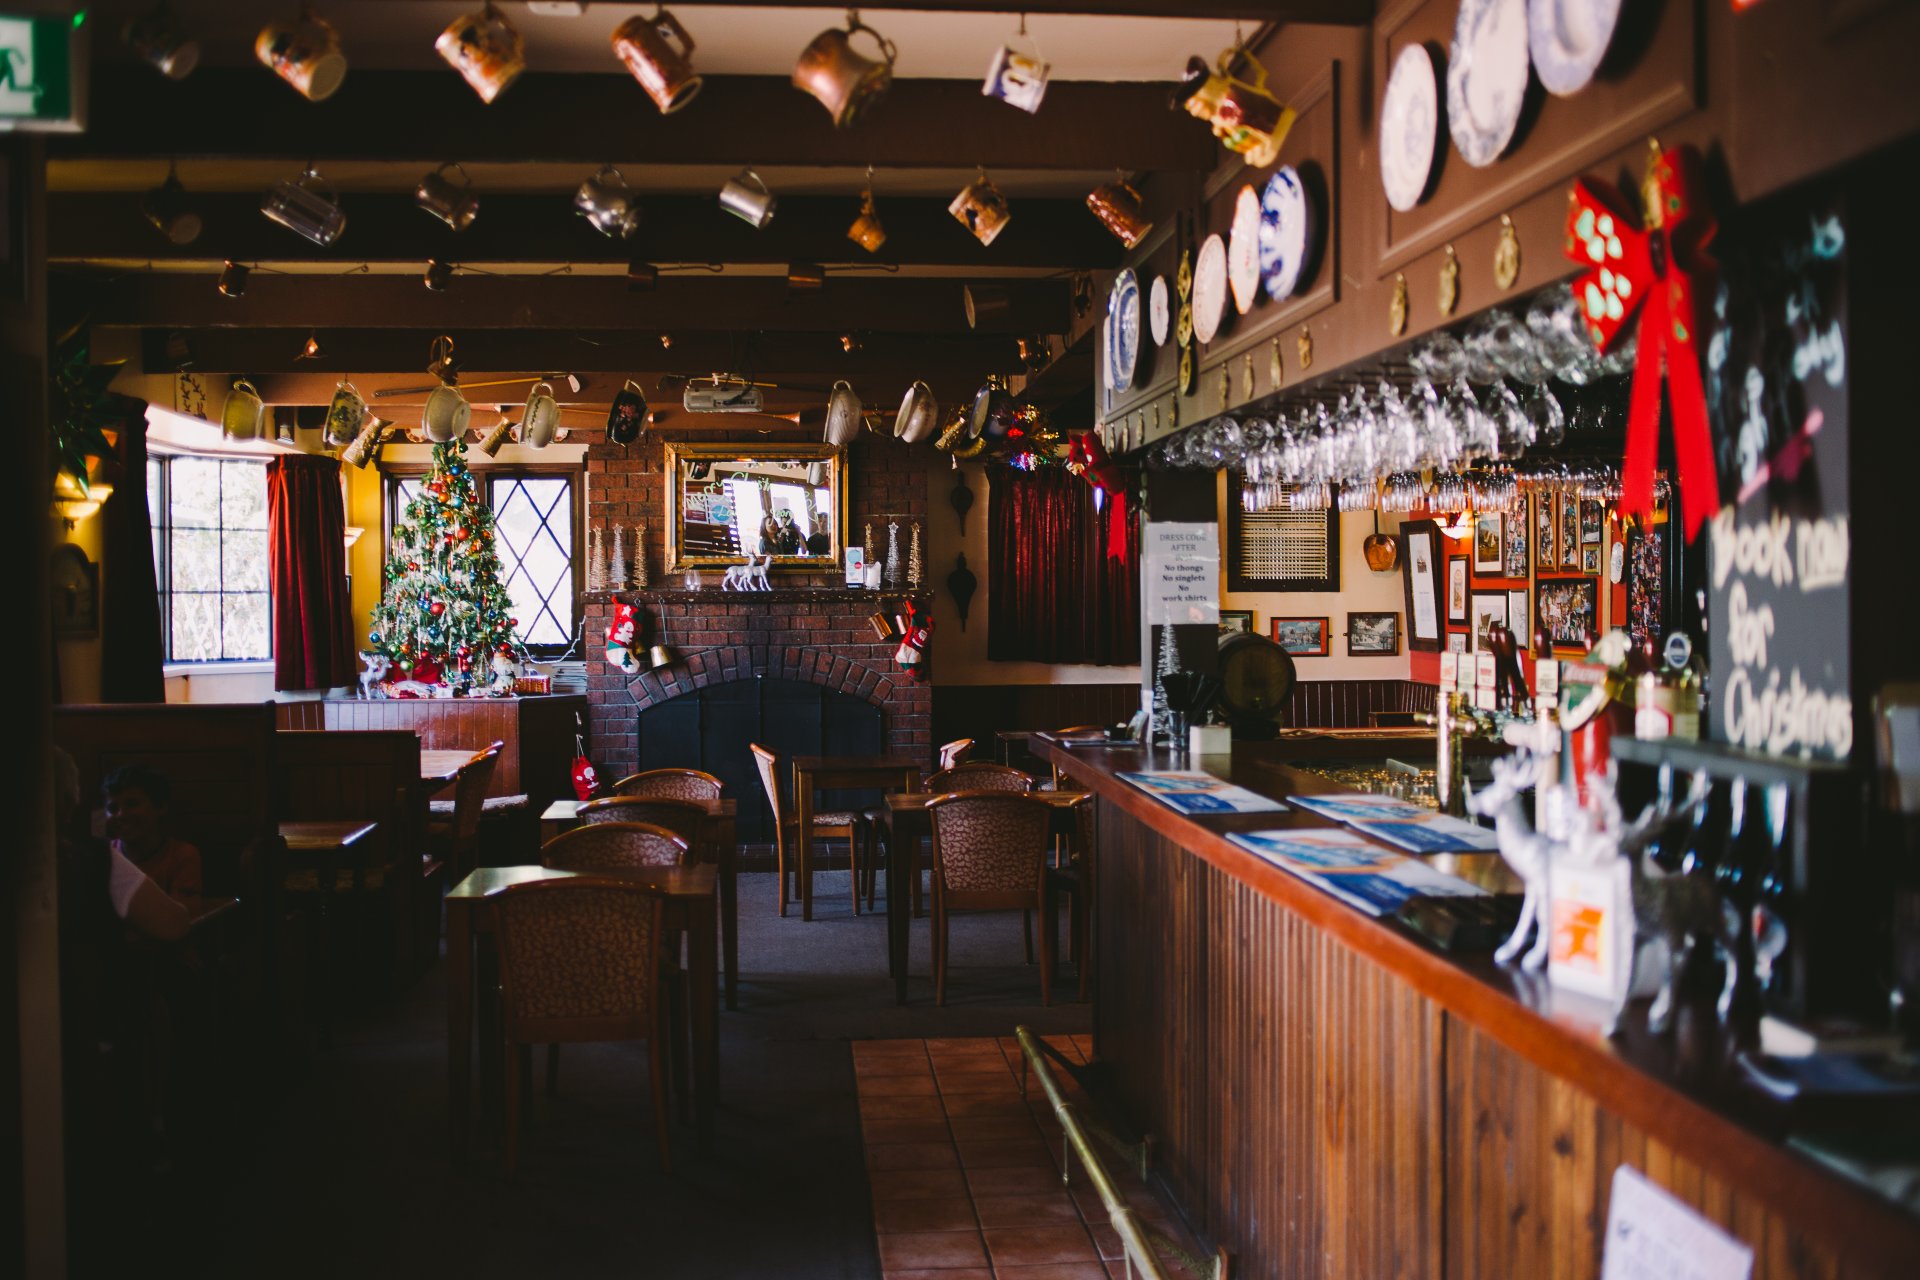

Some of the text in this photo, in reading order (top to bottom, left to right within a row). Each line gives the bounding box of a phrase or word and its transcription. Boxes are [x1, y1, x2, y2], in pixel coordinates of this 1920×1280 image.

[1160, 533, 1184, 541] DRESS
[1177, 564, 1204, 572] thongs
[1175, 574, 1205, 582] singlets
[1178, 584, 1189, 592] No
[1727, 579, 1774, 671] for
[1724, 665, 1853, 761] Christmas
